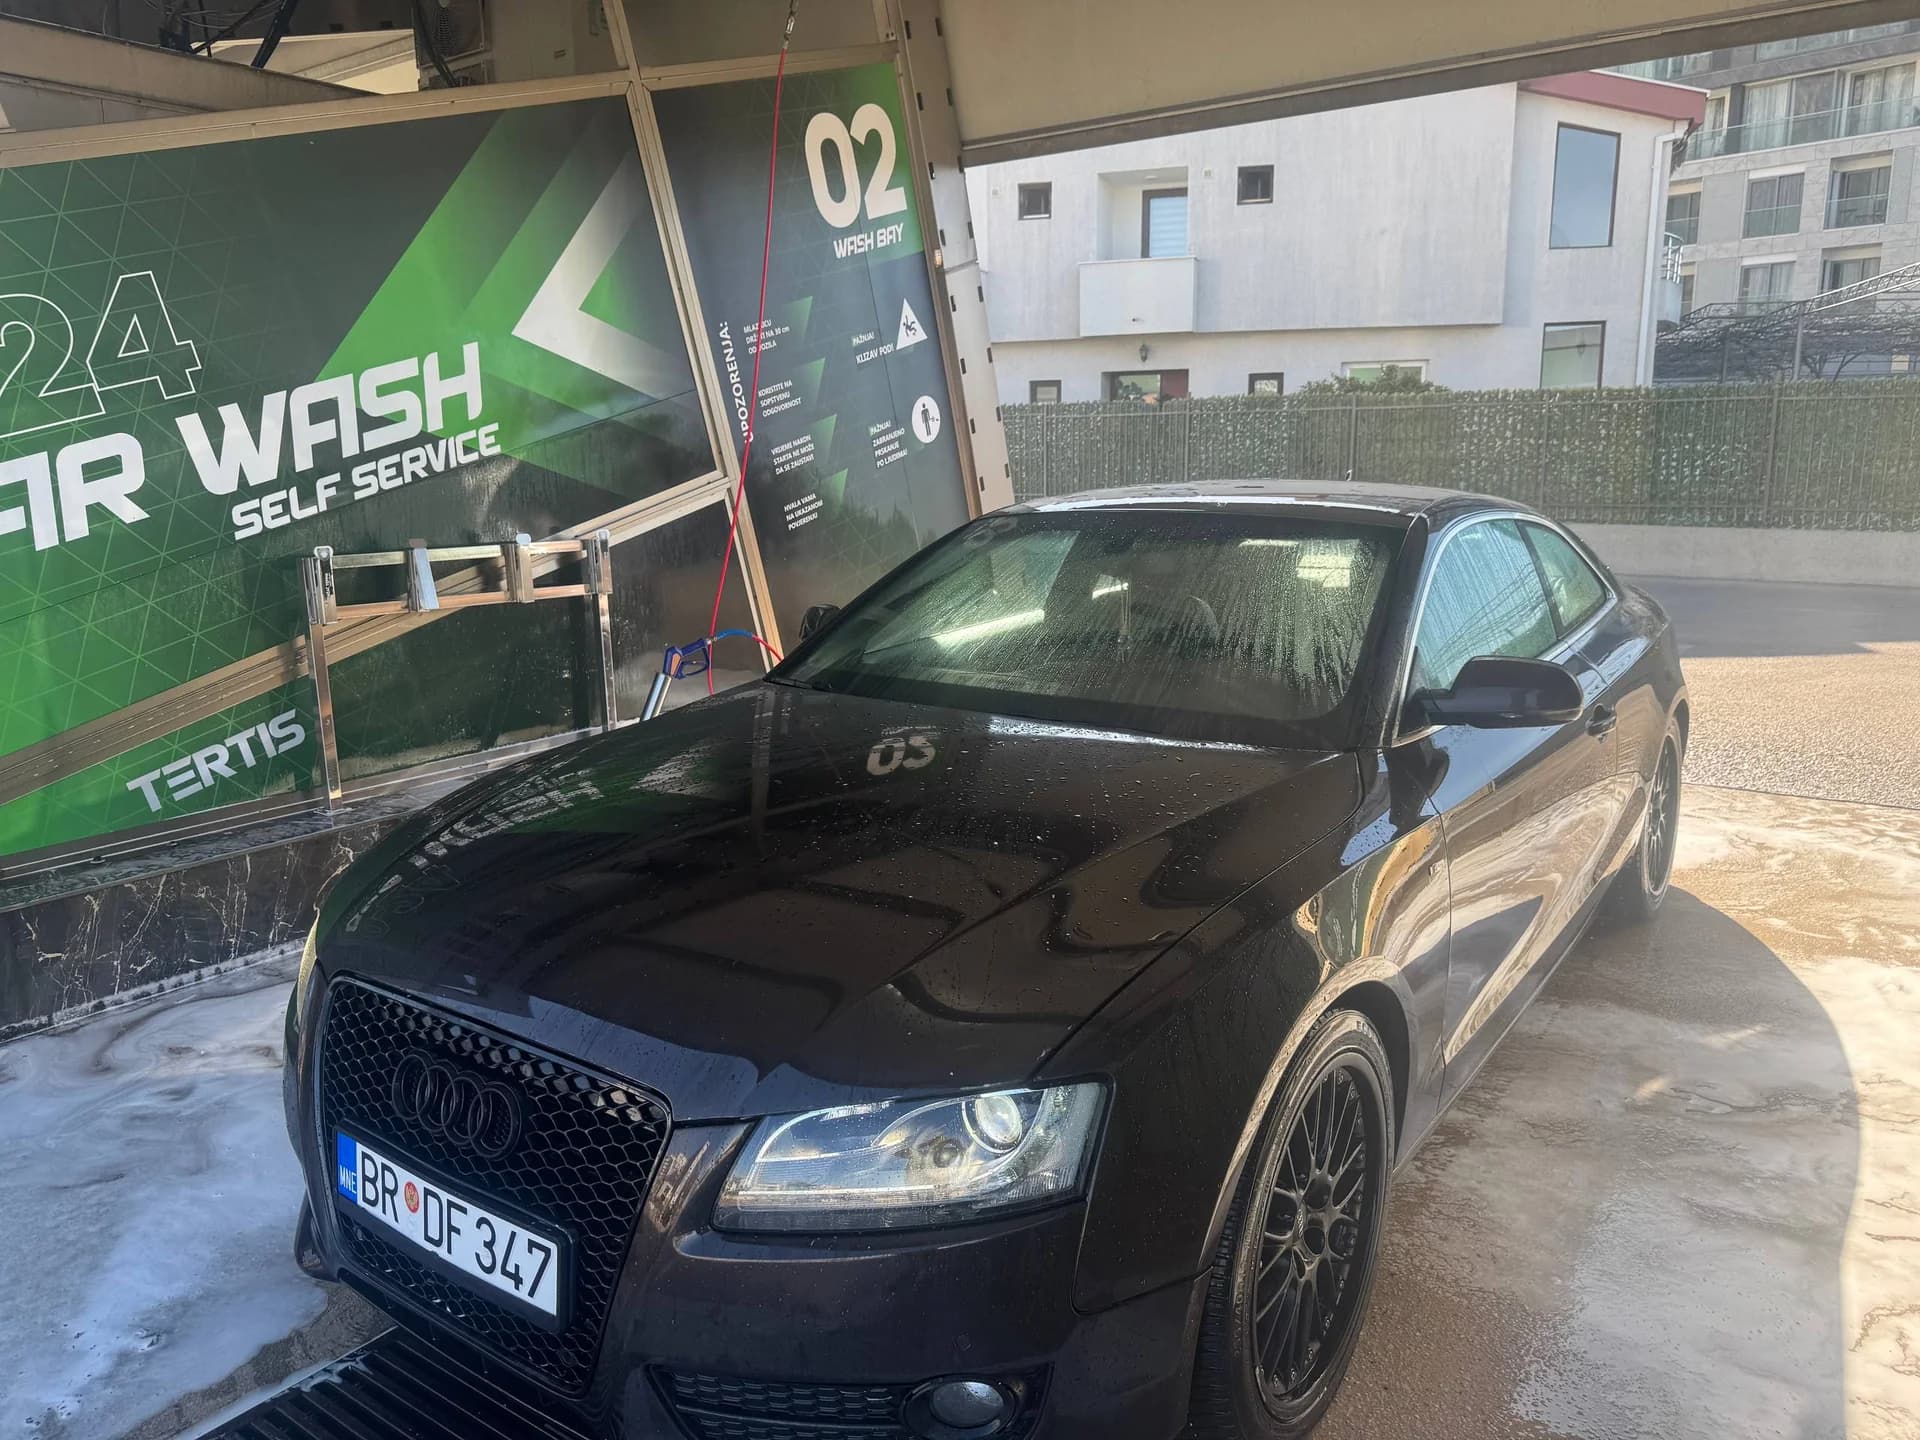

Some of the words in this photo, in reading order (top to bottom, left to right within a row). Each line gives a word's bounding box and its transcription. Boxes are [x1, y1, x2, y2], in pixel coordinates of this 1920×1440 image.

[805, 103, 908, 229] 02
[833, 233, 874, 259] WASH
[876, 222, 904, 248] BAY
[855, 347, 879, 365] KLIZAV
[174, 341, 483, 496] WASH
[231, 472, 341, 541] SELF
[352, 422, 501, 500] SERVICE
[126, 708, 306, 812] TERTIS
[338, 1164, 358, 1195] MNE
[361, 1150, 400, 1224] BR
